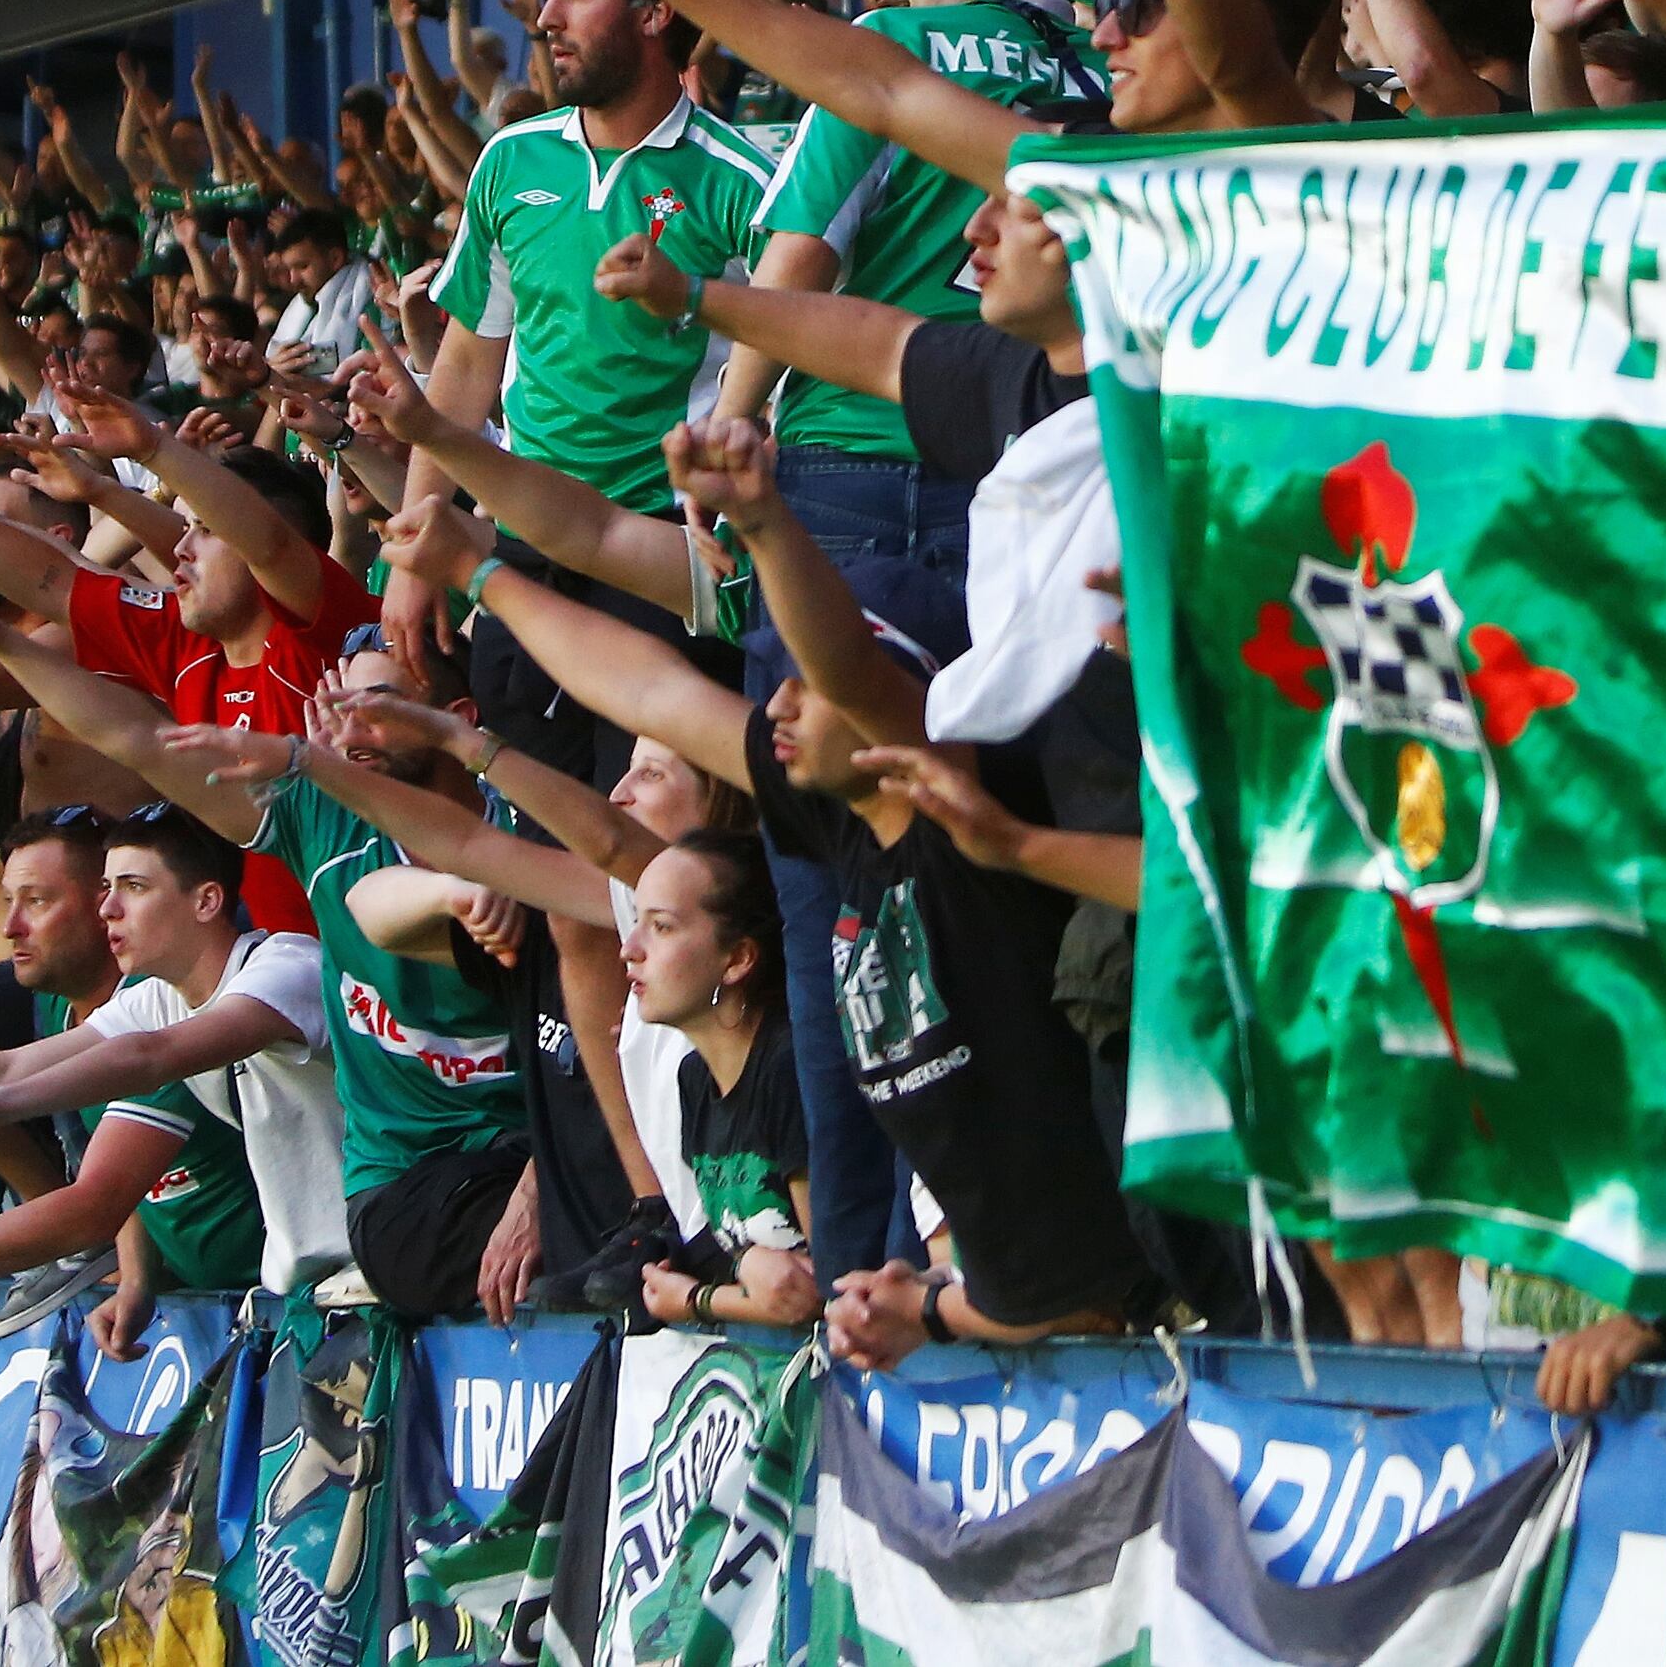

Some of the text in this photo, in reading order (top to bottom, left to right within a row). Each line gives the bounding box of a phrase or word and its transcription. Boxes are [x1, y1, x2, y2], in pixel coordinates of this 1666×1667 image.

[926, 29, 1106, 100] MÉND
[1264, 164, 1467, 374] CLUB
[1464, 160, 1581, 372] DE
